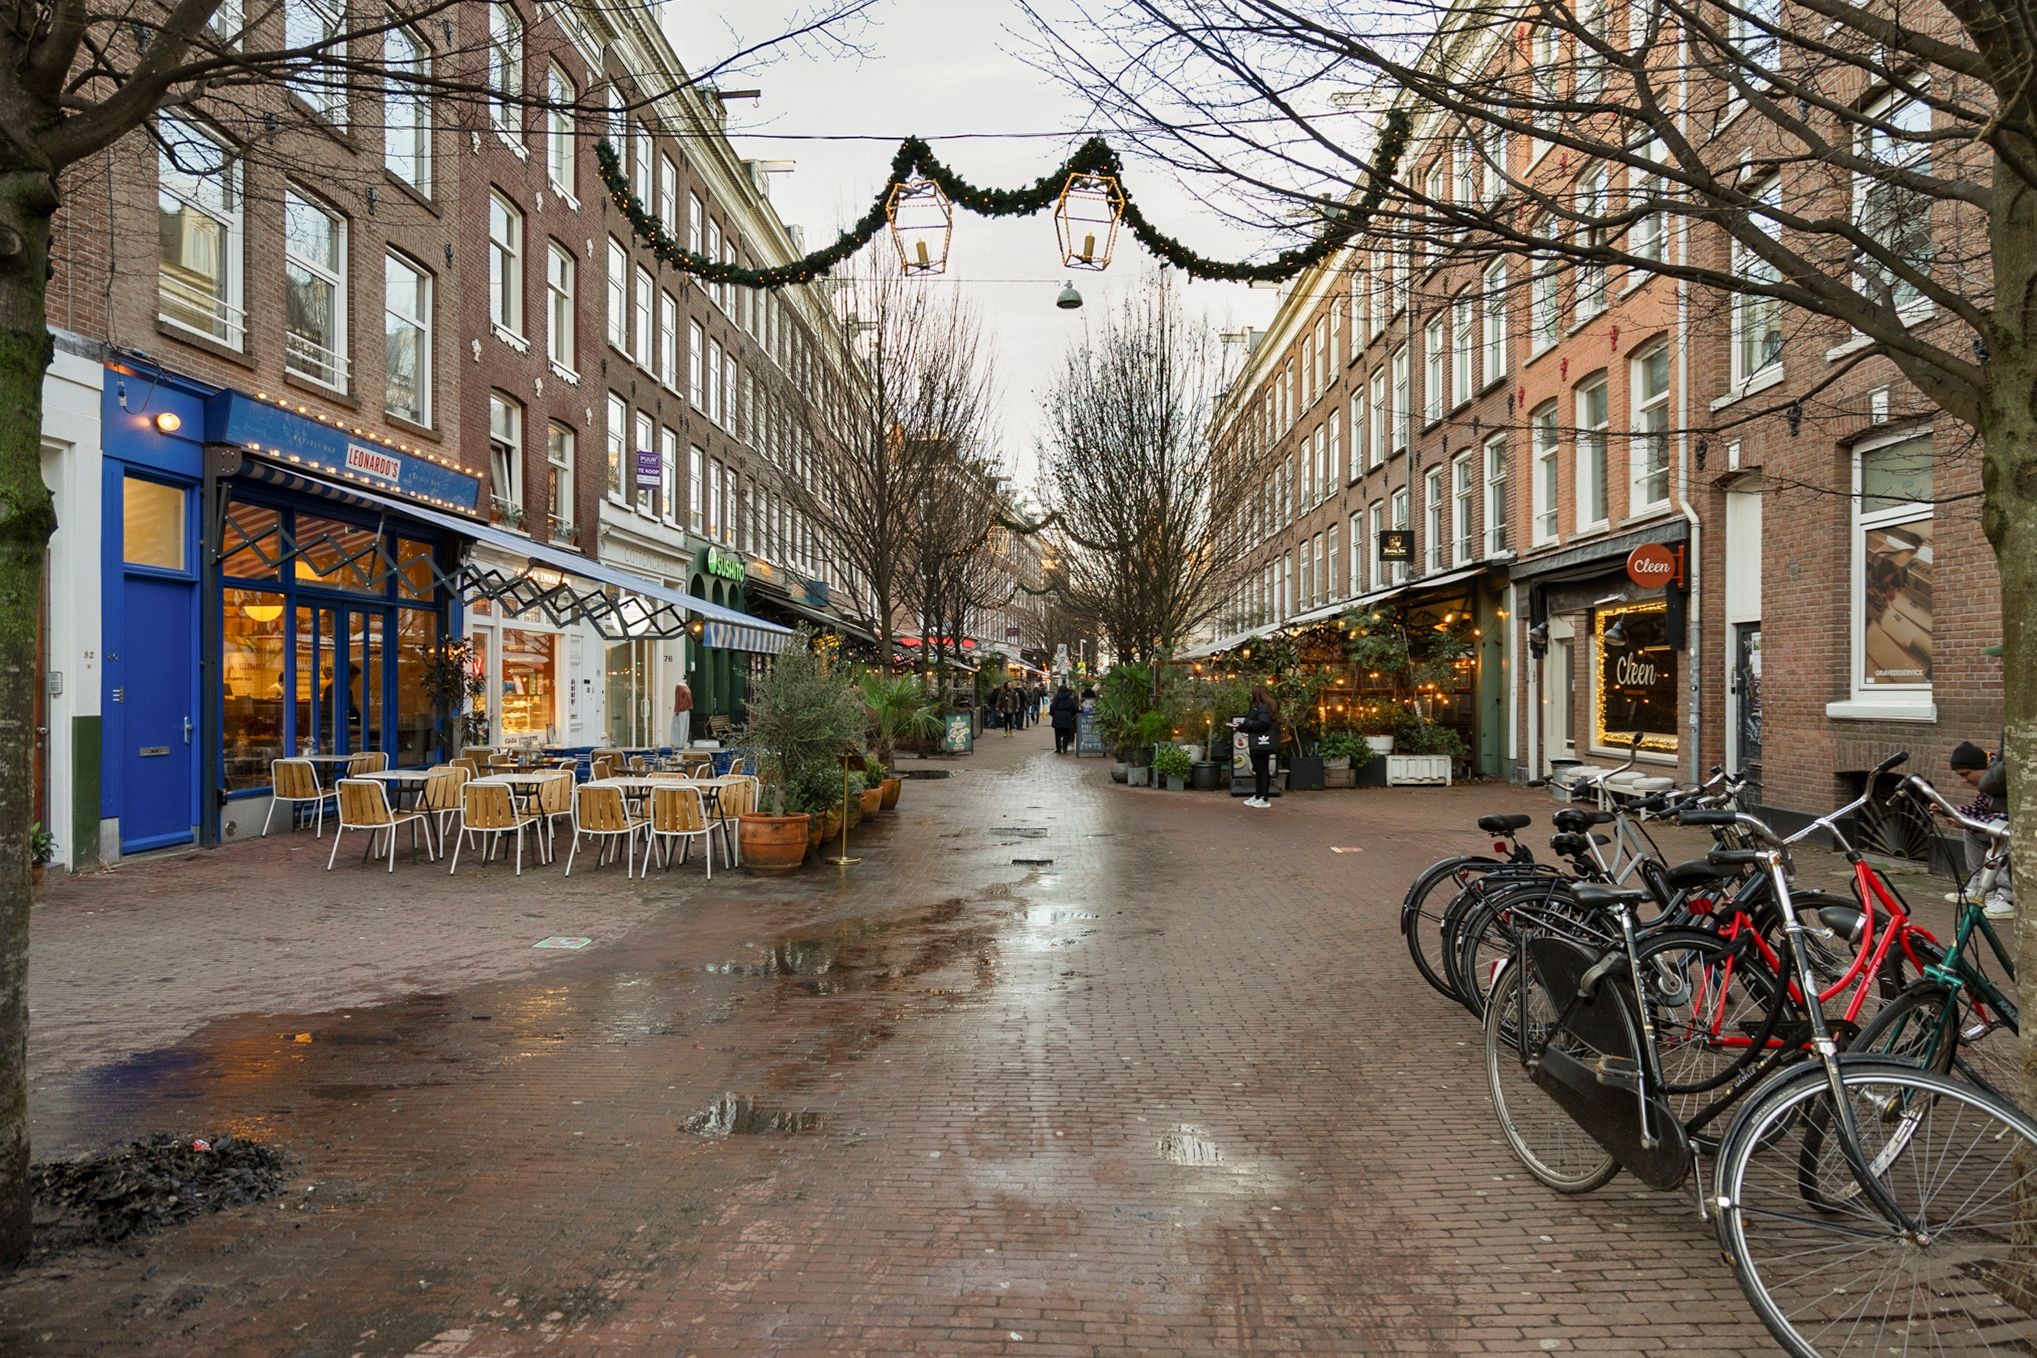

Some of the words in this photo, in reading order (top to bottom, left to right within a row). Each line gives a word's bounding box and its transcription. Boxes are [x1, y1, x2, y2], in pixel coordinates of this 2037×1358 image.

[348, 448, 398, 478] LEONARDO'S
[1634, 558, 1670, 573] Cleen
[1617, 652, 1657, 685] Cleen
